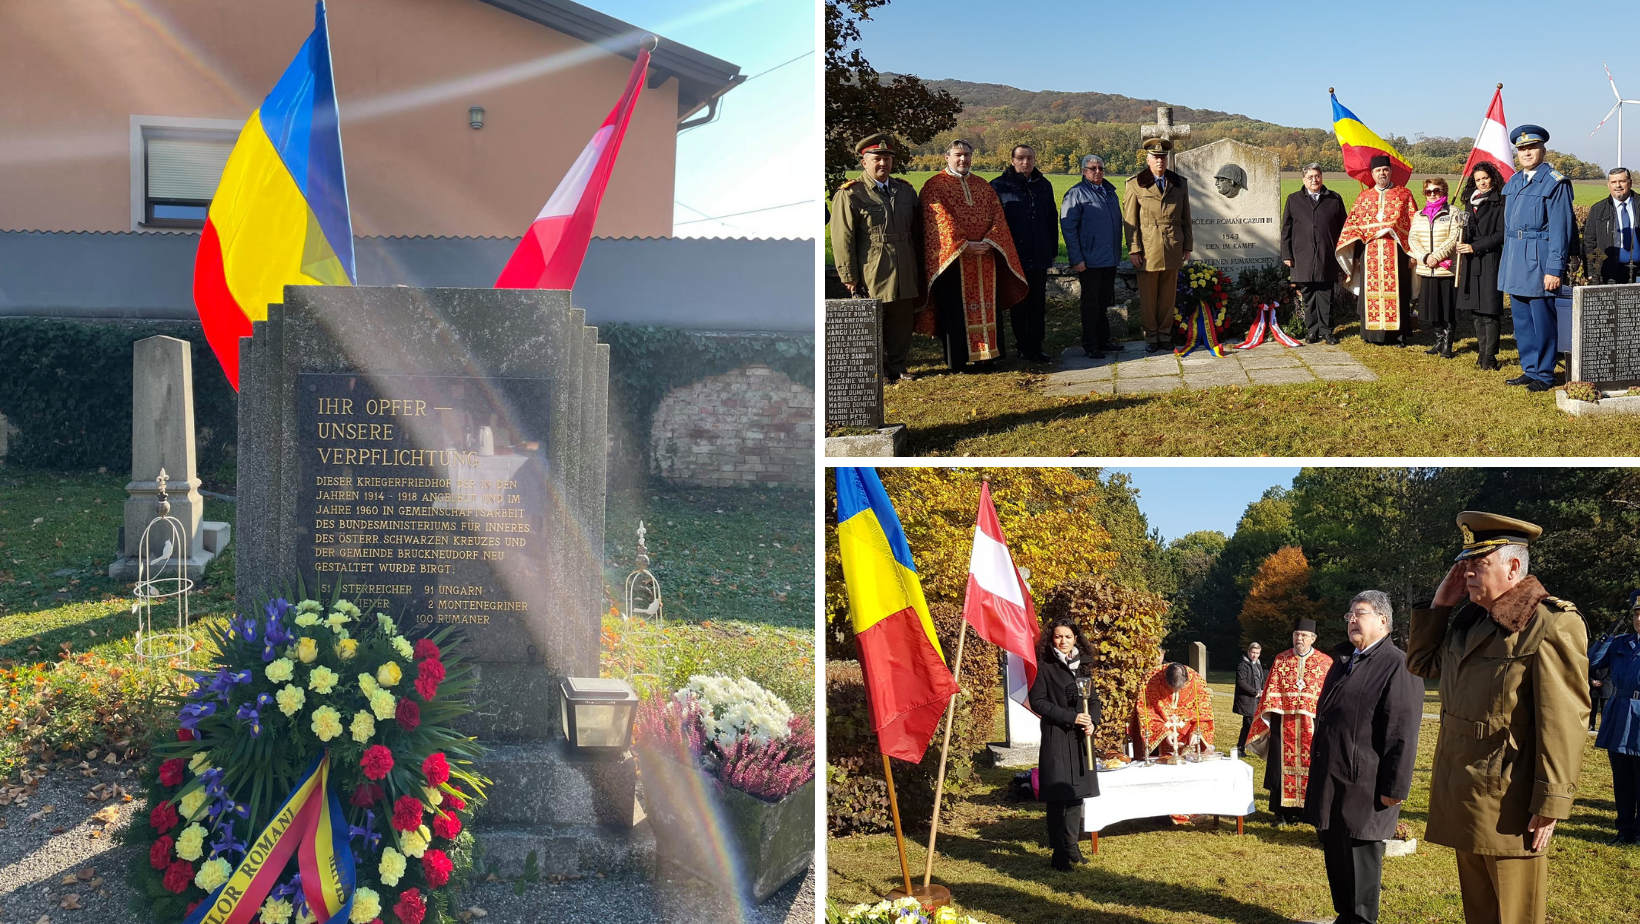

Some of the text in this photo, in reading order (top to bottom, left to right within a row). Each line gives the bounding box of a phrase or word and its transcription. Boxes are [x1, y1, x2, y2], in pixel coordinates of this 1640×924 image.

[318, 397, 354, 415] IHR
[366, 398, 427, 416] OPFER
[318, 422, 394, 440] UNSERE
[318, 448, 479, 467] VERPFLICHTUNG
[316, 476, 353, 486] DIESER
[356, 477, 452, 488] KRIEGERFRIEDHOF
[496, 480, 517, 490] DEN
[316, 491, 359, 500] JAHREN
[364, 492, 384, 501] 1914
[398, 492, 417, 501] 1918
[422, 492, 476, 503] ANGELEGT
[482, 494, 503, 504] UND
[508, 495, 521, 504] IM
[316, 506, 525, 518] JAHRE 1960 IN GEMEINSCHAFTSARBEIT
[316, 520, 335, 529] DES
[339, 520, 456, 531] BUNDESMINISTERIUMS
[461, 520, 481, 532] FÜR
[315, 534, 334, 543] DES
[384, 535, 449, 545] SCHWARZEN
[453, 536, 501, 546] KREUZES
[505, 538, 526, 547] UND
[315, 548, 504, 560] DER GEMEINDE BRUCKNEUDORF NEU
[315, 562, 456, 574] GESTALTET WURDE BIRGT:
[337, 584, 412, 594] STERREICHER
[424, 585, 483, 596] 91 UNGARN
[428, 600, 528, 611] 2 MONTENEGRINER
[416, 614, 434, 623] 100
[204, 806, 296, 924] LOR ROMANI
